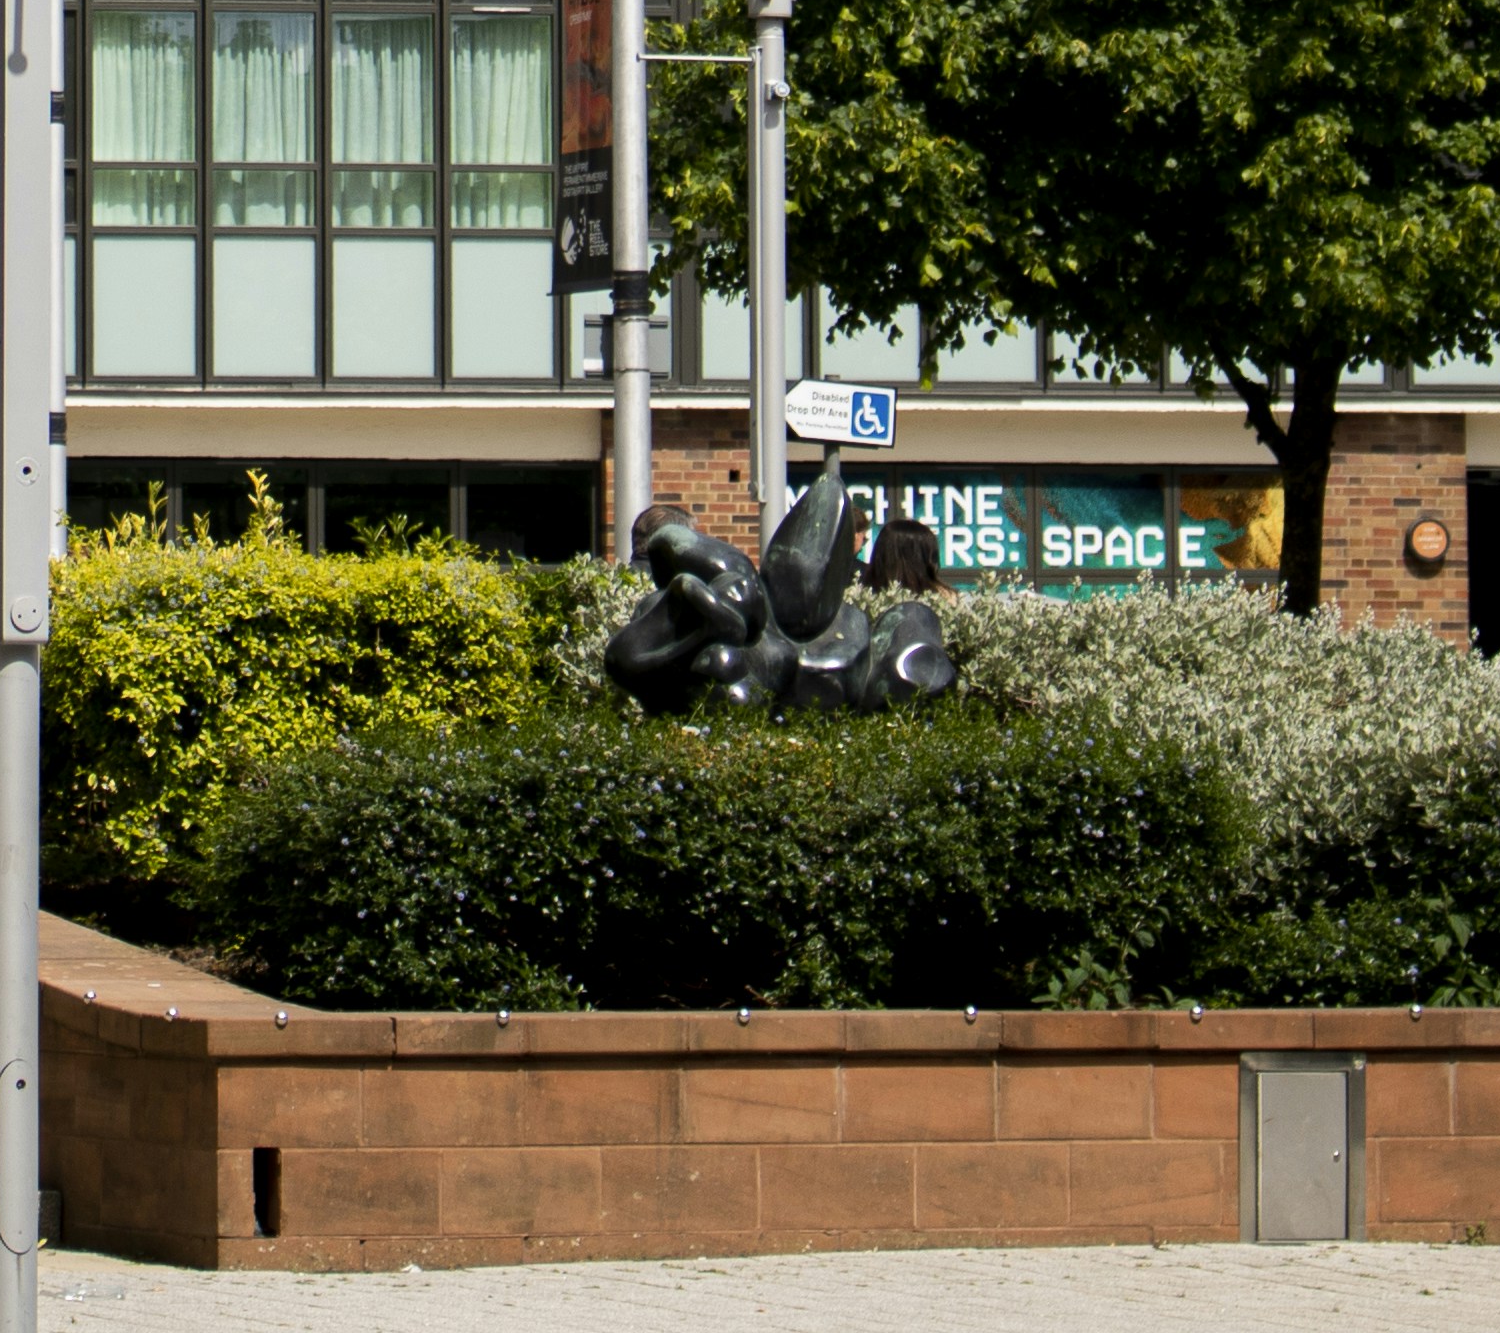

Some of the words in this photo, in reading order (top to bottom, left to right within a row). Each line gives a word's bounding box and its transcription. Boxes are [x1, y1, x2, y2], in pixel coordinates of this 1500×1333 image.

[812, 391, 850, 404] Disabled
[787, 404, 809, 416] Drop
[811, 406, 826, 416] Off
[828, 408, 849, 419] Area
[1042, 525, 1206, 568] SPACE
